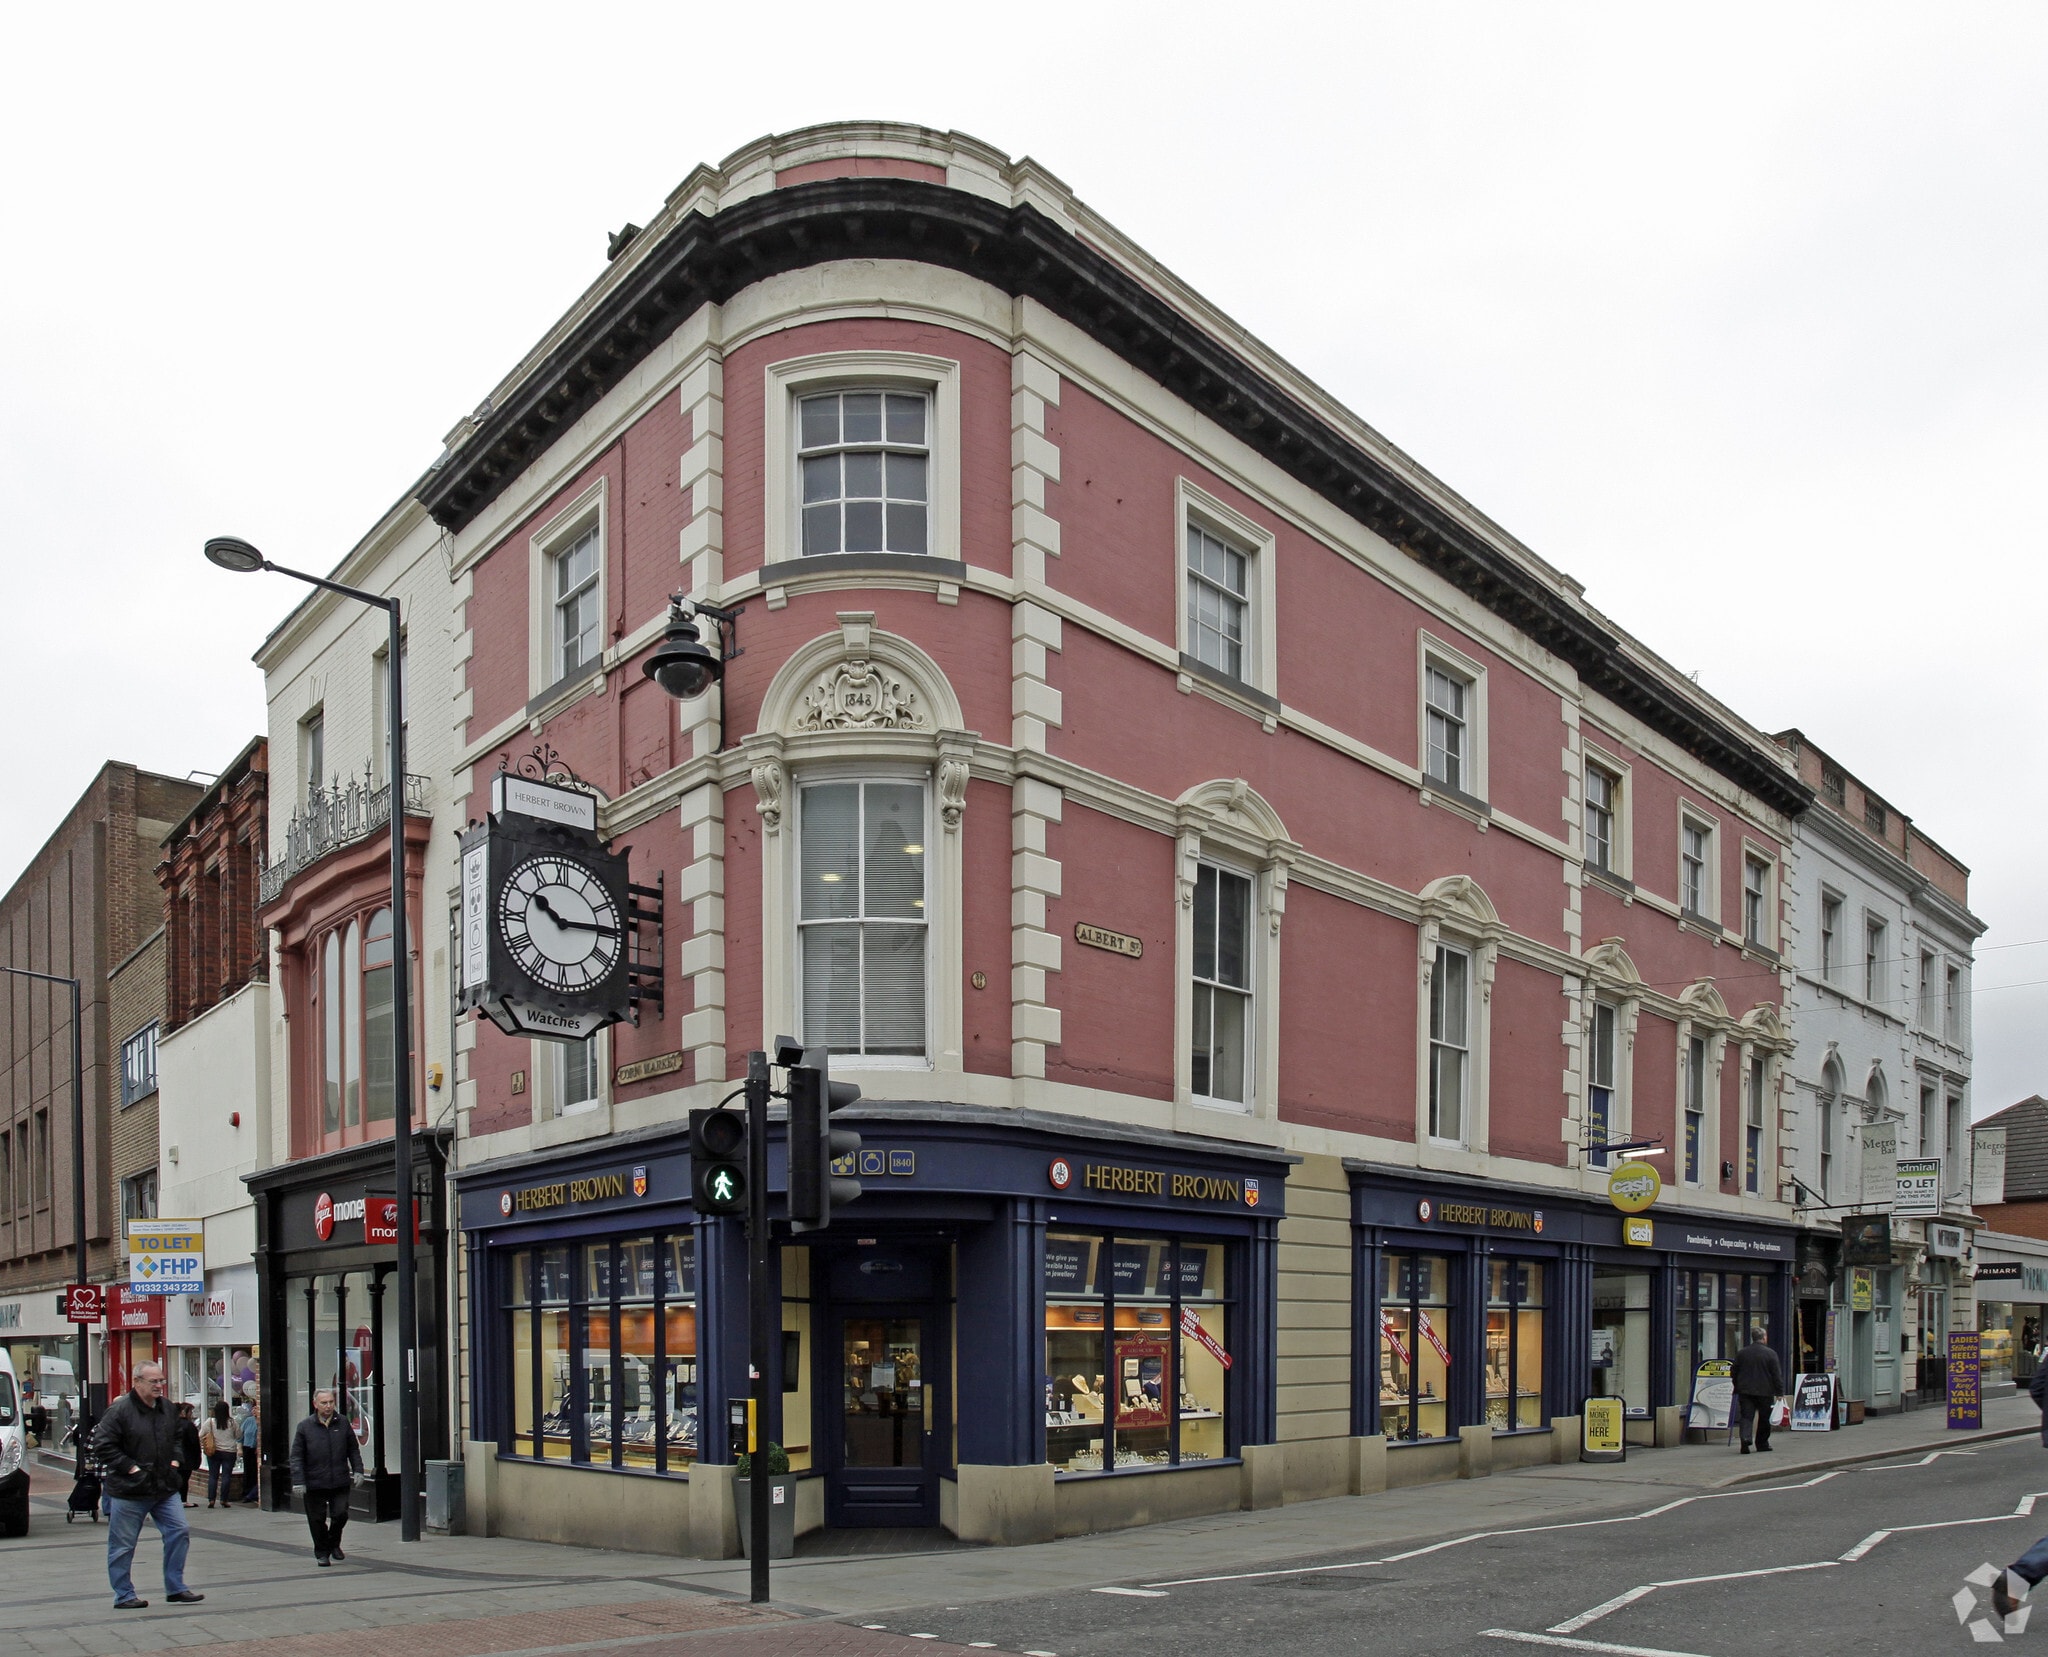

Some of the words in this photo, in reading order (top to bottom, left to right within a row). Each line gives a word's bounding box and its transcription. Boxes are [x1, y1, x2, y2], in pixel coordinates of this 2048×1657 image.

[515, 792, 550, 807] HERBERT
[554, 801, 586, 816] BROWN
[1079, 928, 1124, 950] ALBERT
[527, 1009, 580, 1029] Watches
[643, 1055, 677, 1074] MARKET
[1863, 1139, 1896, 1149] Metro
[1976, 1142, 2006, 1150] Metro
[1881, 1147, 1896, 1155] Bar
[892, 1158, 911, 1167] 1840
[1896, 1163, 1935, 1173] admiral
[1086, 1164, 1165, 1194] HERBERT
[1171, 1173, 1239, 1201] BROWN
[1246, 1181, 1257, 1190] NPA
[1611, 1175, 1655, 1194] cash
[1897, 1179, 1912, 1189] TO
[1916, 1178, 1936, 1188] LET
[516, 1183, 566, 1211] HERBERT
[570, 1173, 624, 1203] BROWN
[1439, 1203, 1488, 1225] HERBERT
[1491, 1208, 1532, 1229] BROWN
[1630, 1223, 1652, 1242] cash
[138, 1238, 160, 1249] TO
[163, 1237, 192, 1249] LET
[1686, 1235, 1712, 1248] Pawnbroking
[1720, 1238, 1734, 1248] Cheque
[1734, 1240, 1747, 1250] cashing
[1055, 1254, 1067, 1262] give
[160, 1258, 198, 1275] FHP
[1121, 1261, 1141, 1269] vintage
[1051, 1271, 1076, 1279] jewellery
[1977, 1267, 2017, 1275] PRIMARK
[135, 1284, 161, 1292] 01332
[162, 1283, 180, 1291] 343
[181, 1283, 199, 1291] 222
[189, 1298, 205, 1317] Card
[208, 1297, 226, 1316] Zone
[121, 1308, 149, 1326] Foundation
[1184, 1308, 1200, 1325] MEGA
[1950, 1336, 1979, 1344] LADIES
[1950, 1344, 1978, 1352] Stiletto
[1801, 1385, 1828, 1394] WINTER
[1589, 1427, 1609, 1438] HERE
